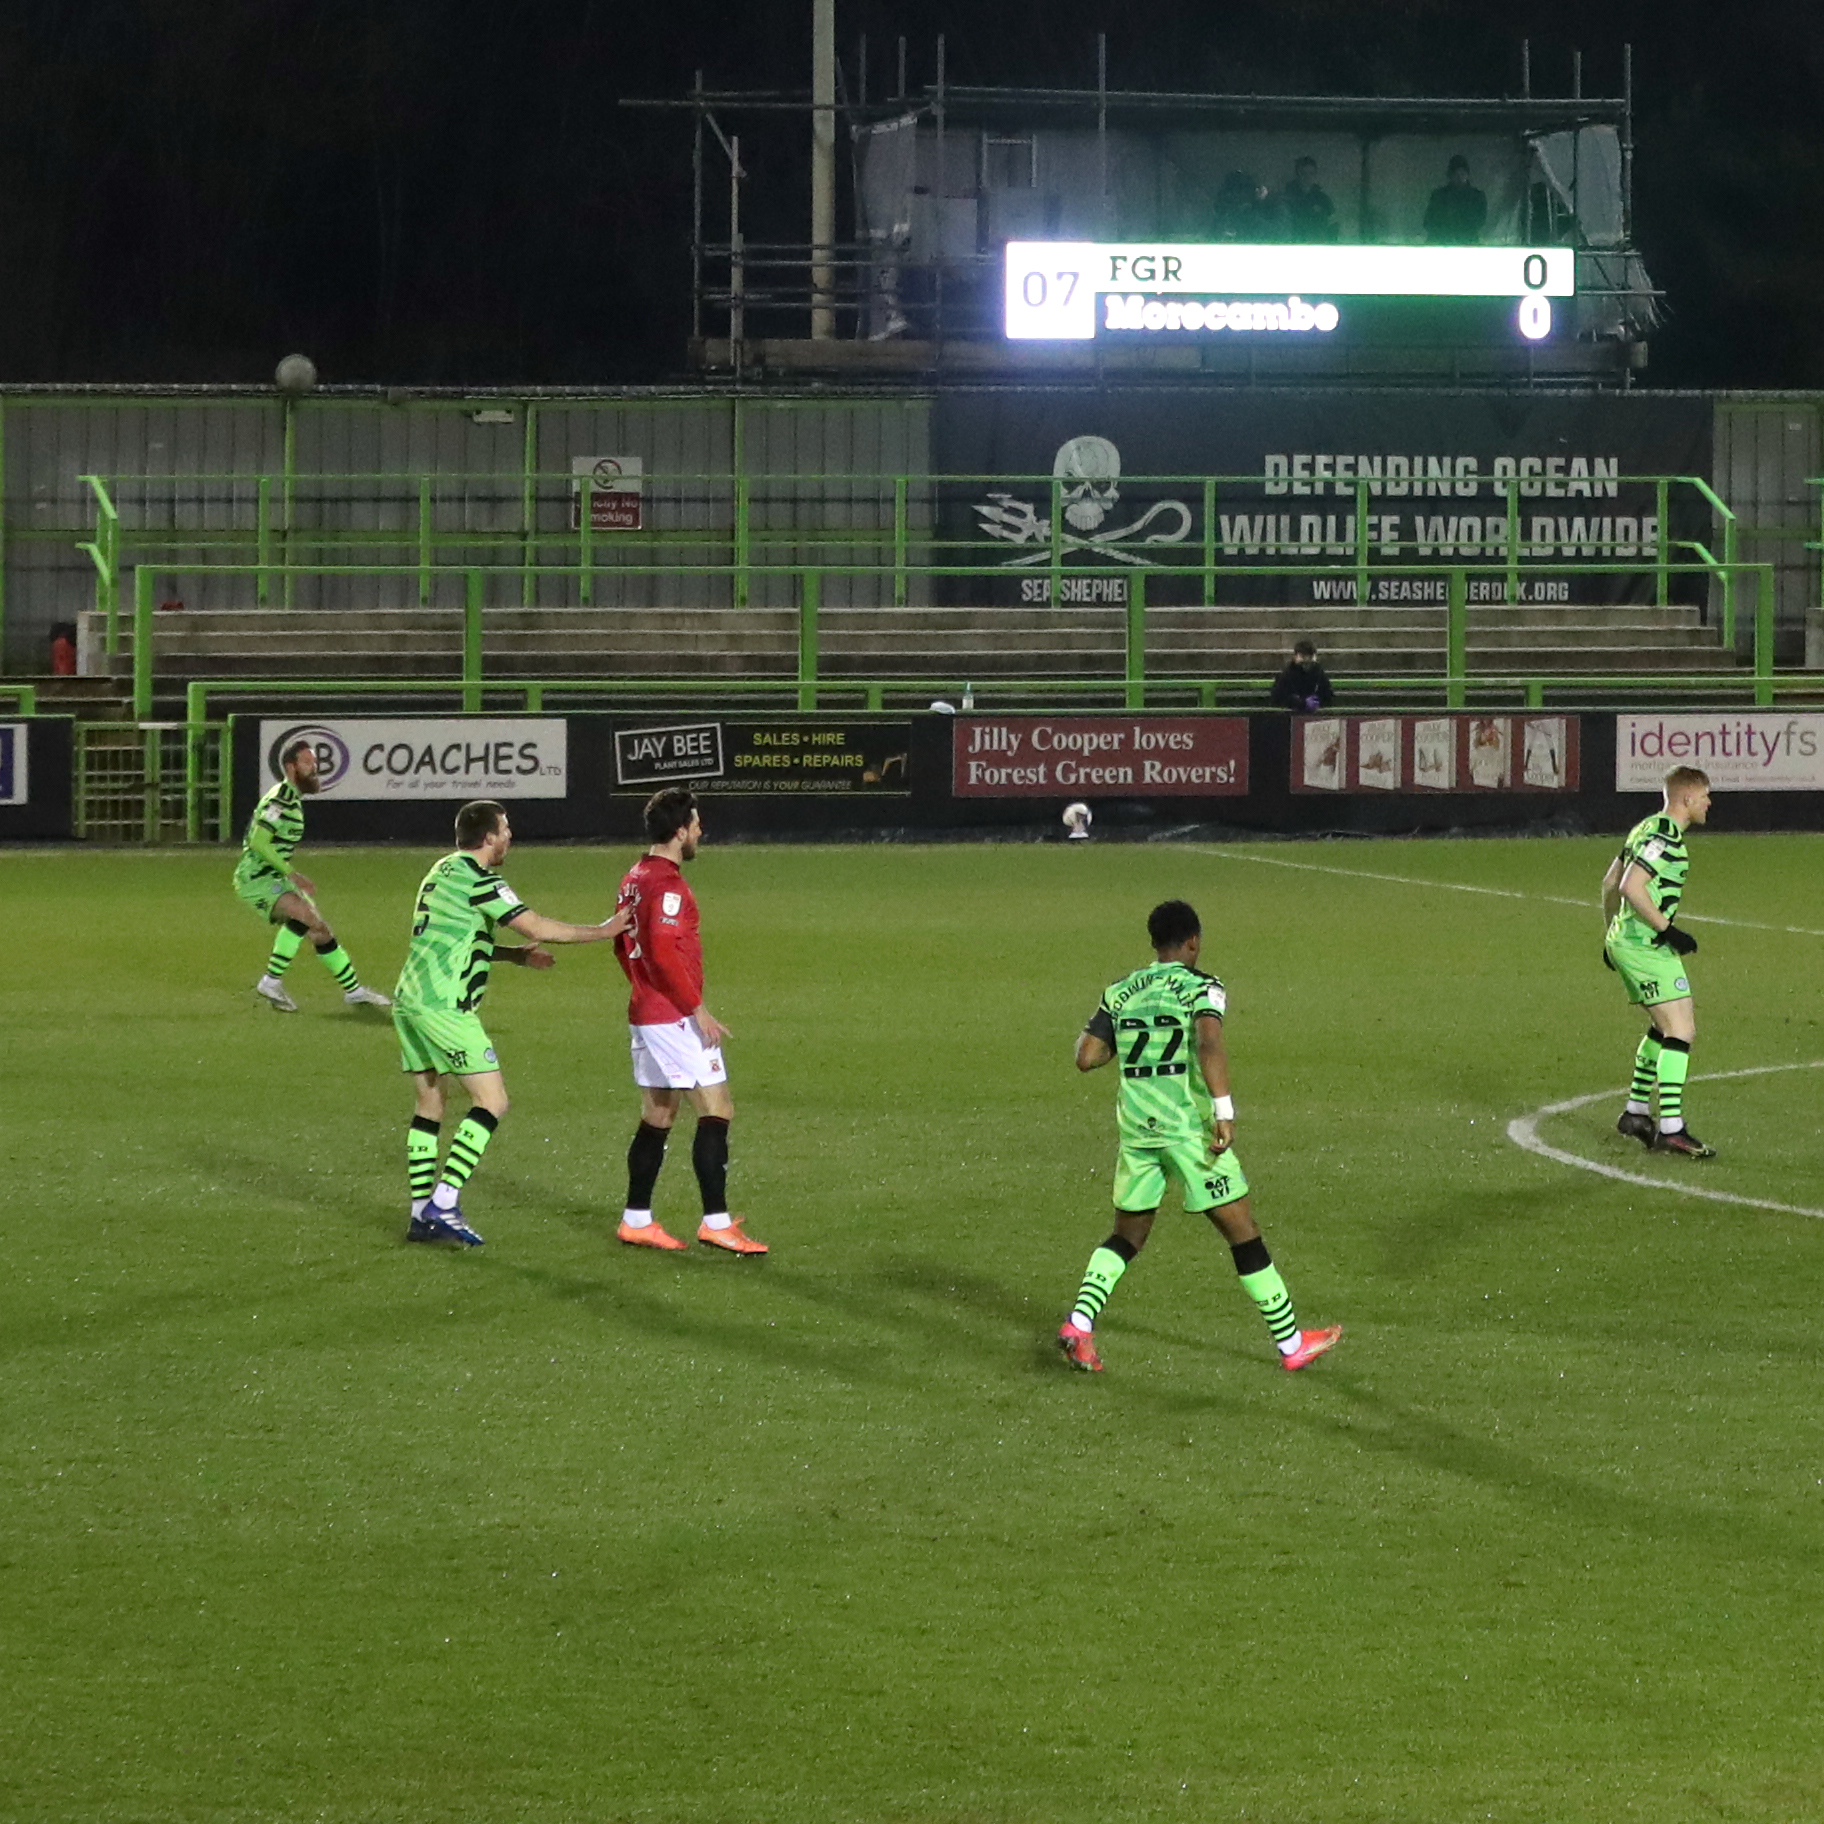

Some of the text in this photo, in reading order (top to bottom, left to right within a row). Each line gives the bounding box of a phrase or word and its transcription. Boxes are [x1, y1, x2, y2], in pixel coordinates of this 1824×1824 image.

[1110, 255, 1548, 290] FGR 0
[1023, 271, 1080, 307] 07
[1106, 295, 1552, 339] Morecambe 0
[1265, 454, 1618, 497] DEFENDING OCEAN
[590, 513, 633, 524] moking
[1021, 579, 1130, 602] SEA SHEPHE
[627, 733, 712, 761] JAY BEE
[753, 733, 845, 746] SALES HIRE
[967, 726, 1194, 756] Jilly Cooper loves
[1630, 720, 1818, 767] identityfs
[363, 742, 540, 776] COACHES
[540, 767, 562, 776] LTD
[734, 754, 864, 767] SPARES REPAIRS
[968, 759, 1236, 785] Forest Green Rovers!
[1120, 1014, 1187, 1078] 22
